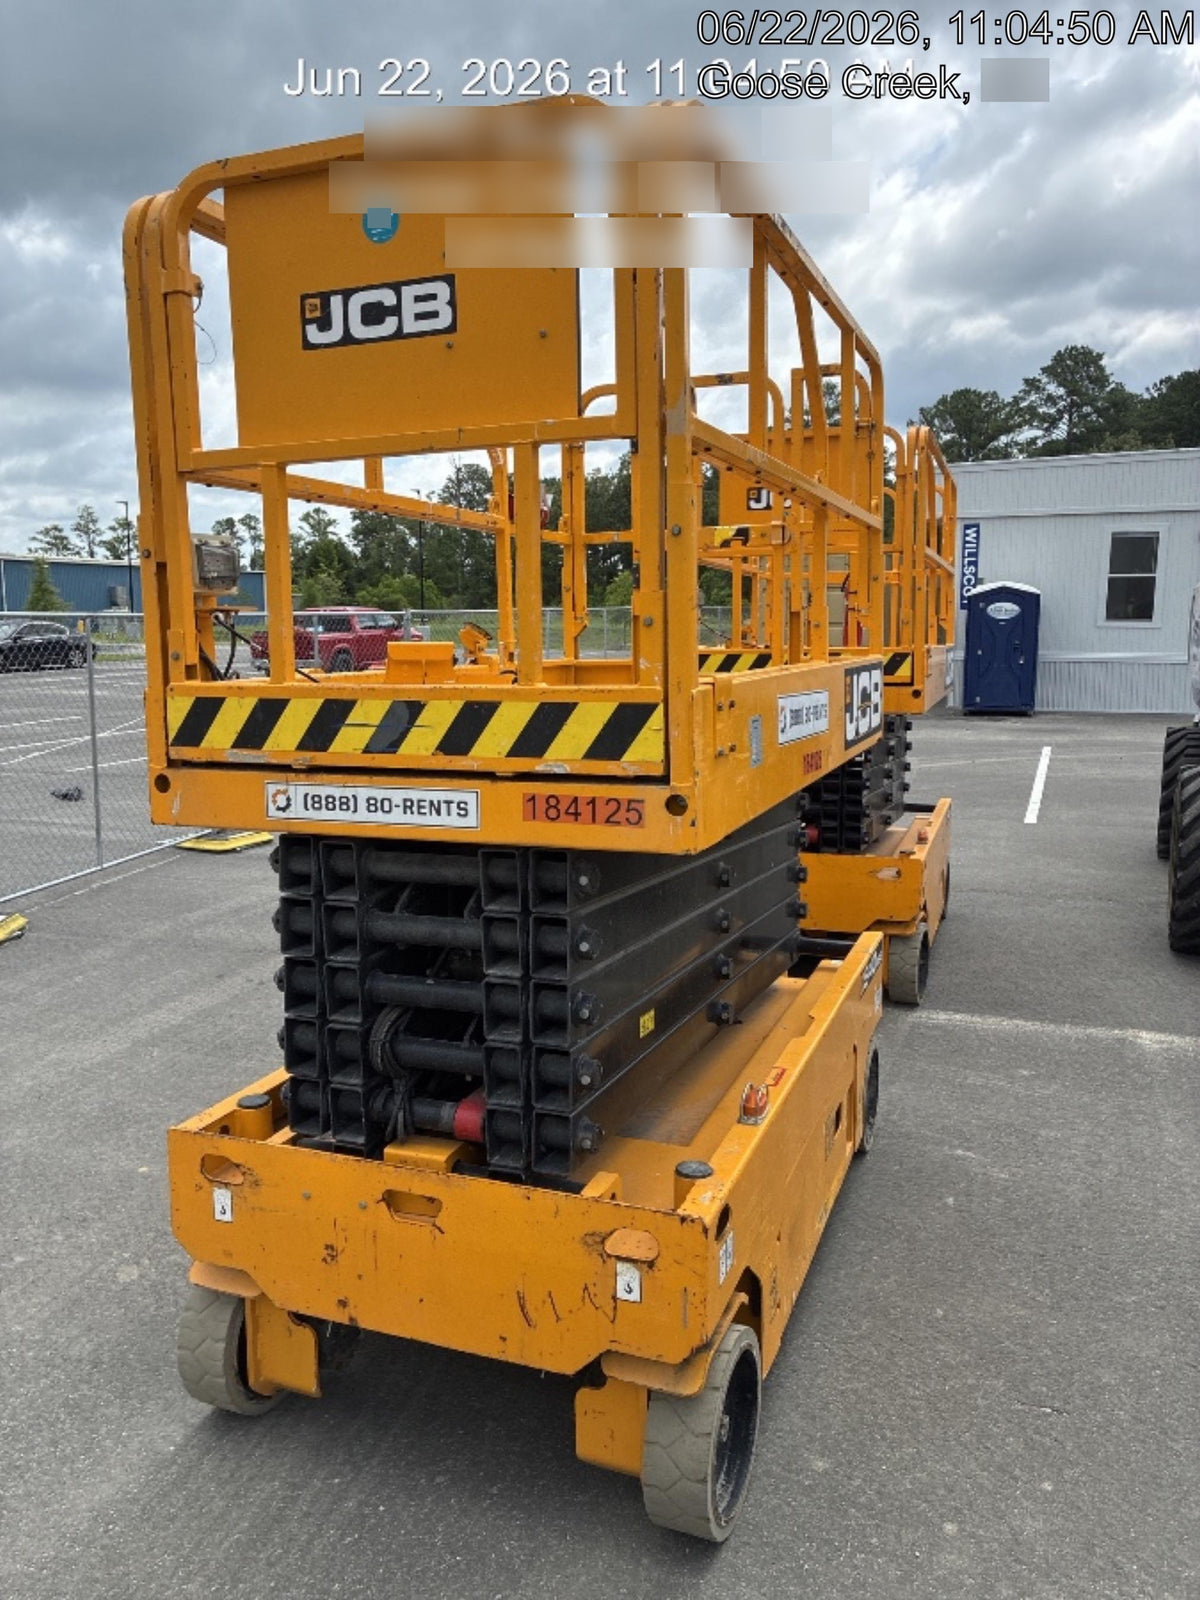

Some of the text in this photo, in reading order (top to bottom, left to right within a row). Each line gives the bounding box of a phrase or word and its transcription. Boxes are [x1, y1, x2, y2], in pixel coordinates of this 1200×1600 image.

[304, 280, 453, 345] JCB
[845, 668, 882, 742] JCB
[303, 791, 469, 819] (888) 80-RENTS
[526, 793, 645, 826] 184125
